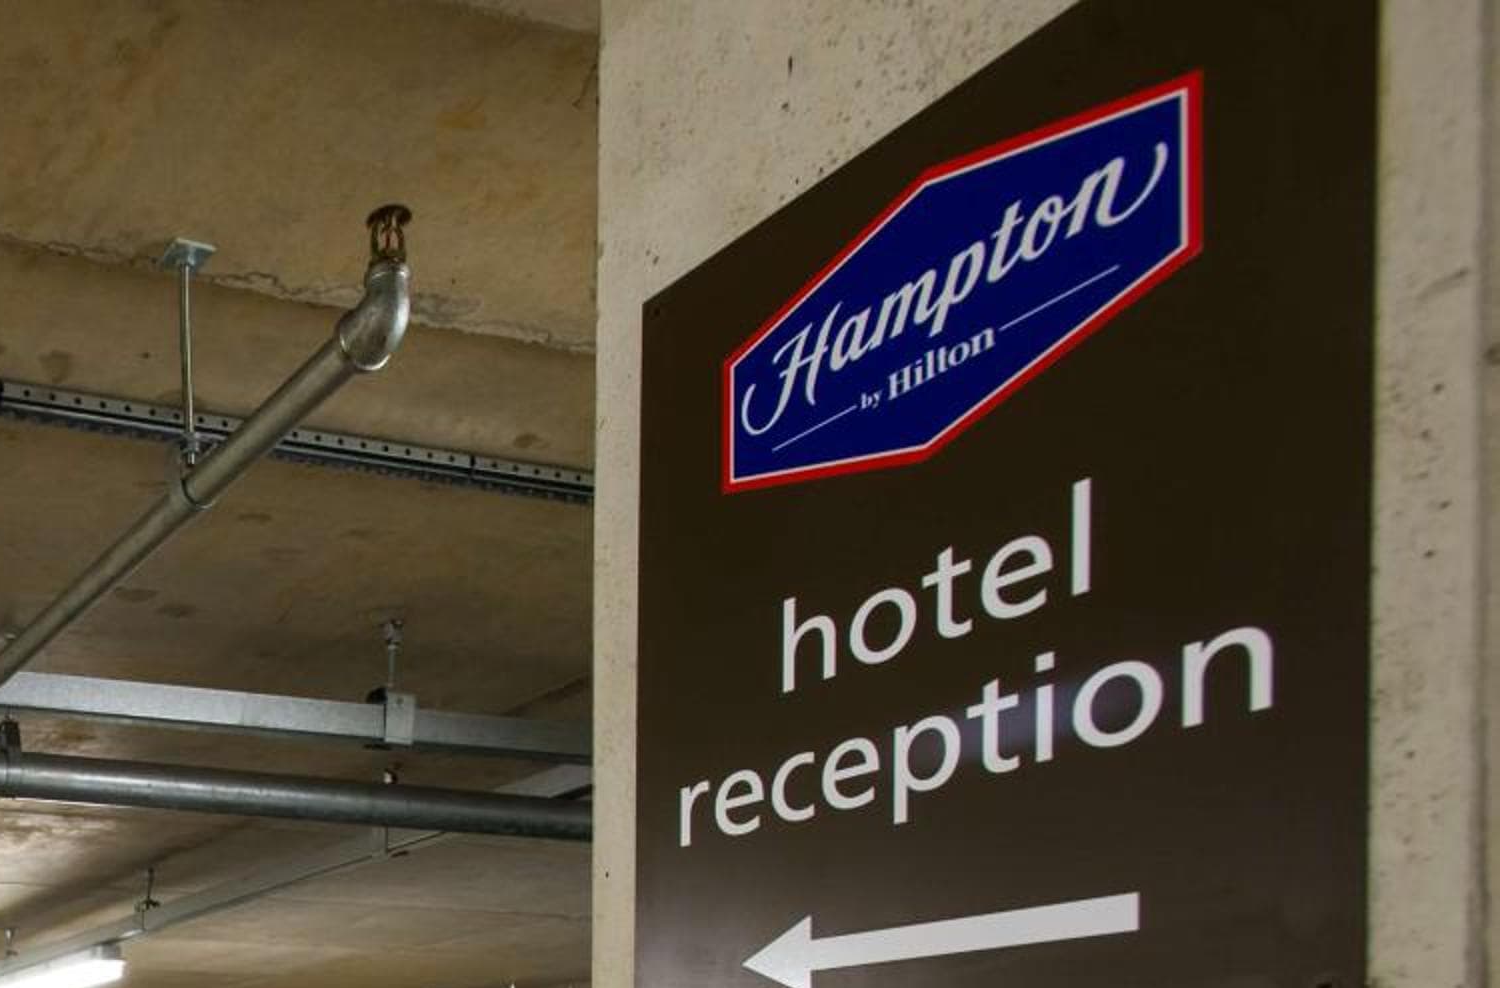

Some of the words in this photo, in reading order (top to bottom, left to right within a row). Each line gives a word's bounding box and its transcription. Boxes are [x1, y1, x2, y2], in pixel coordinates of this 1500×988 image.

[741, 142, 1168, 435] Hampton
[860, 389, 883, 410] by
[887, 327, 995, 401] Hilton
[781, 477, 1092, 693] hotel
[679, 626, 1273, 848] reception
